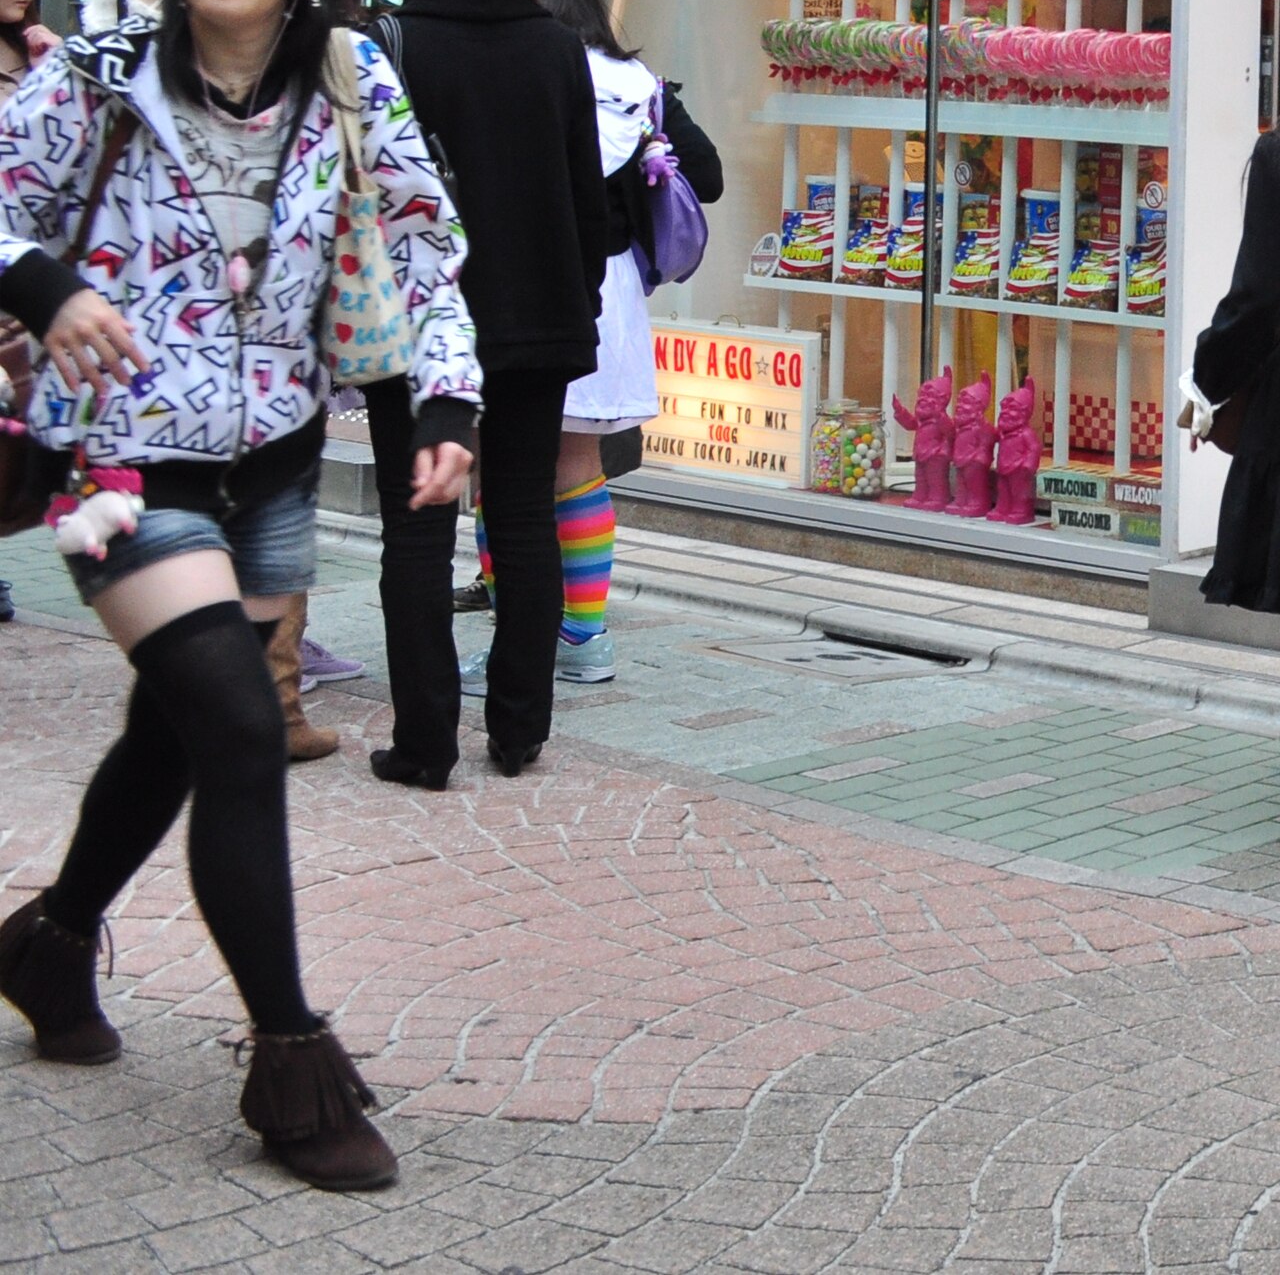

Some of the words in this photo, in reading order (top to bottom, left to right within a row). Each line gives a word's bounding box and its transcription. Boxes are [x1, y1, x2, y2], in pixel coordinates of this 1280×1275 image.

[655, 336, 697, 374] NDY
[701, 401, 726, 421] FUN
[737, 406, 752, 425] TO
[765, 410, 788, 431] MIX
[646, 435, 685, 457] AJUKU
[746, 450, 788, 473] JAPAN
[1043, 476, 1098, 499] WELCOME
[1114, 482, 1161, 506] WELCOM
[1057, 508, 1112, 532] WELCOME
